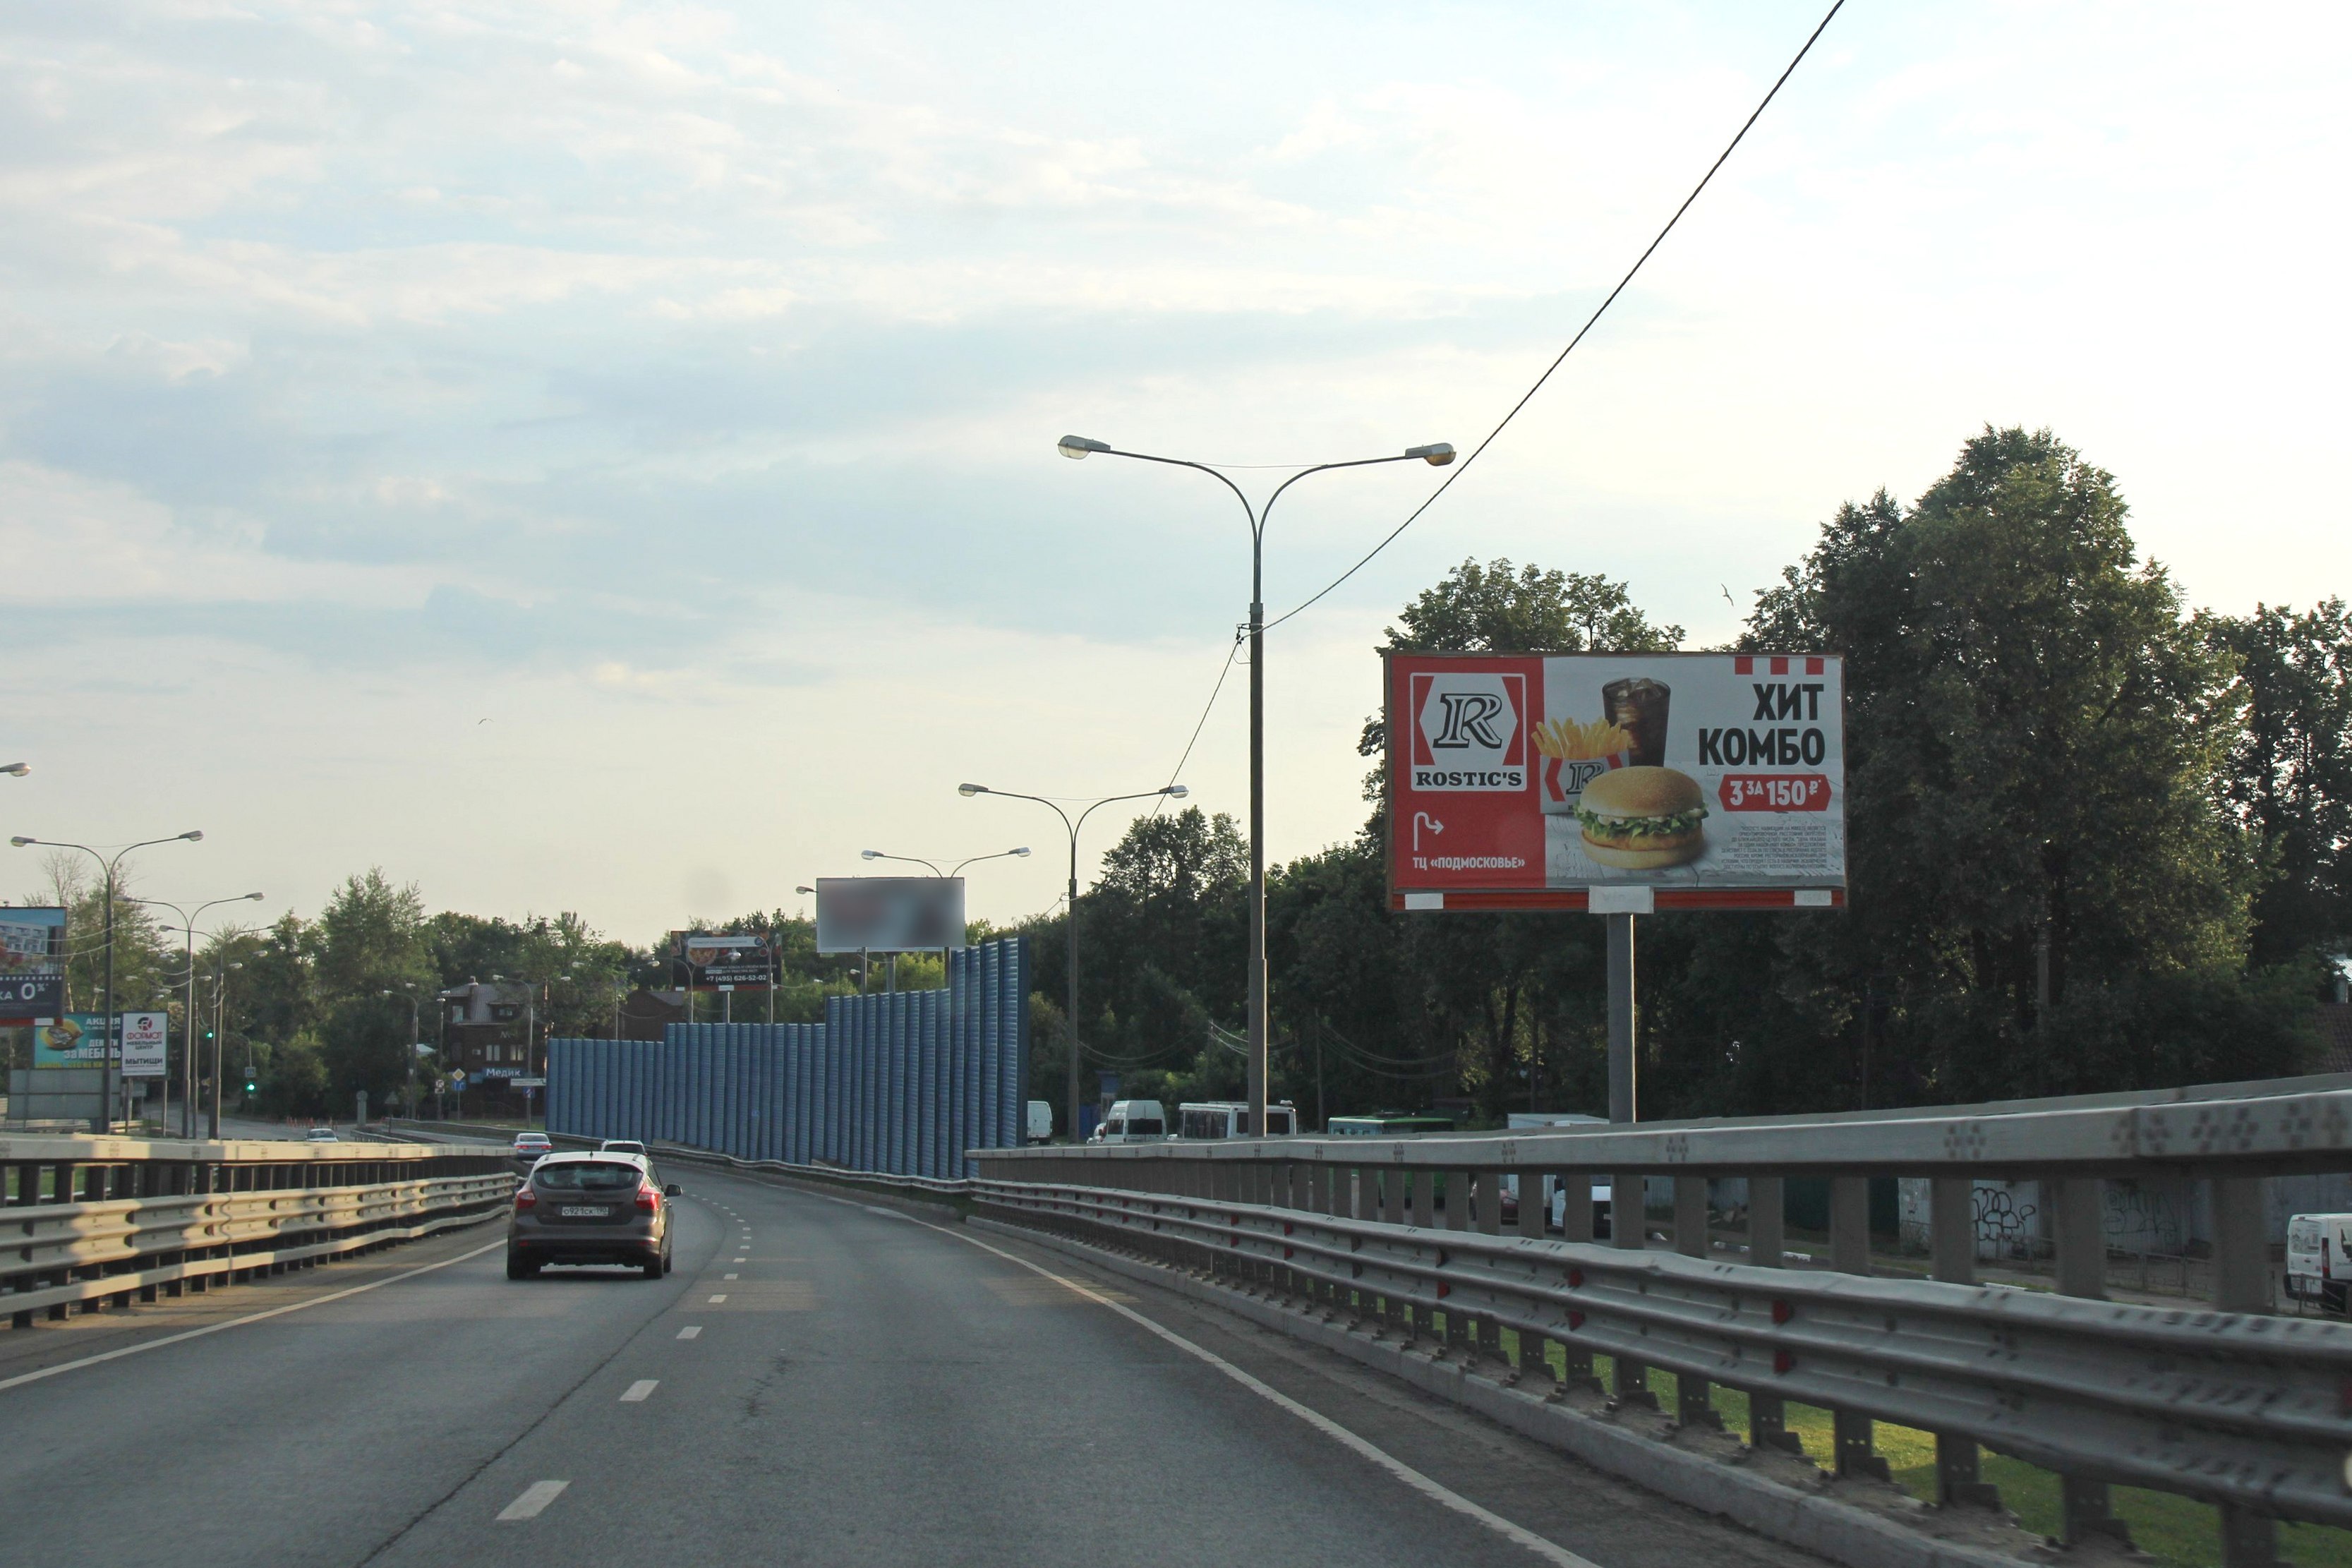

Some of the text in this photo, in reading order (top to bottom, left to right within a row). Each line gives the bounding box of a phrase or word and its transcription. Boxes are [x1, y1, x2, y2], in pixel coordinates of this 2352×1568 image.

[1752, 684, 1824, 720] ХИТ
[1433, 693, 1502, 749] R
[1699, 728, 1826, 766] КОМБО
[1416, 771, 1522, 787] ROSTIC'S
[1730, 780, 1744, 805] 3
[1413, 857, 1526, 870] ТЦ «ПОДМОСКОВЬЕ»
[89, 1039, 119, 1047] ДЕНГИ
[486, 1068, 521, 1078] Медик
